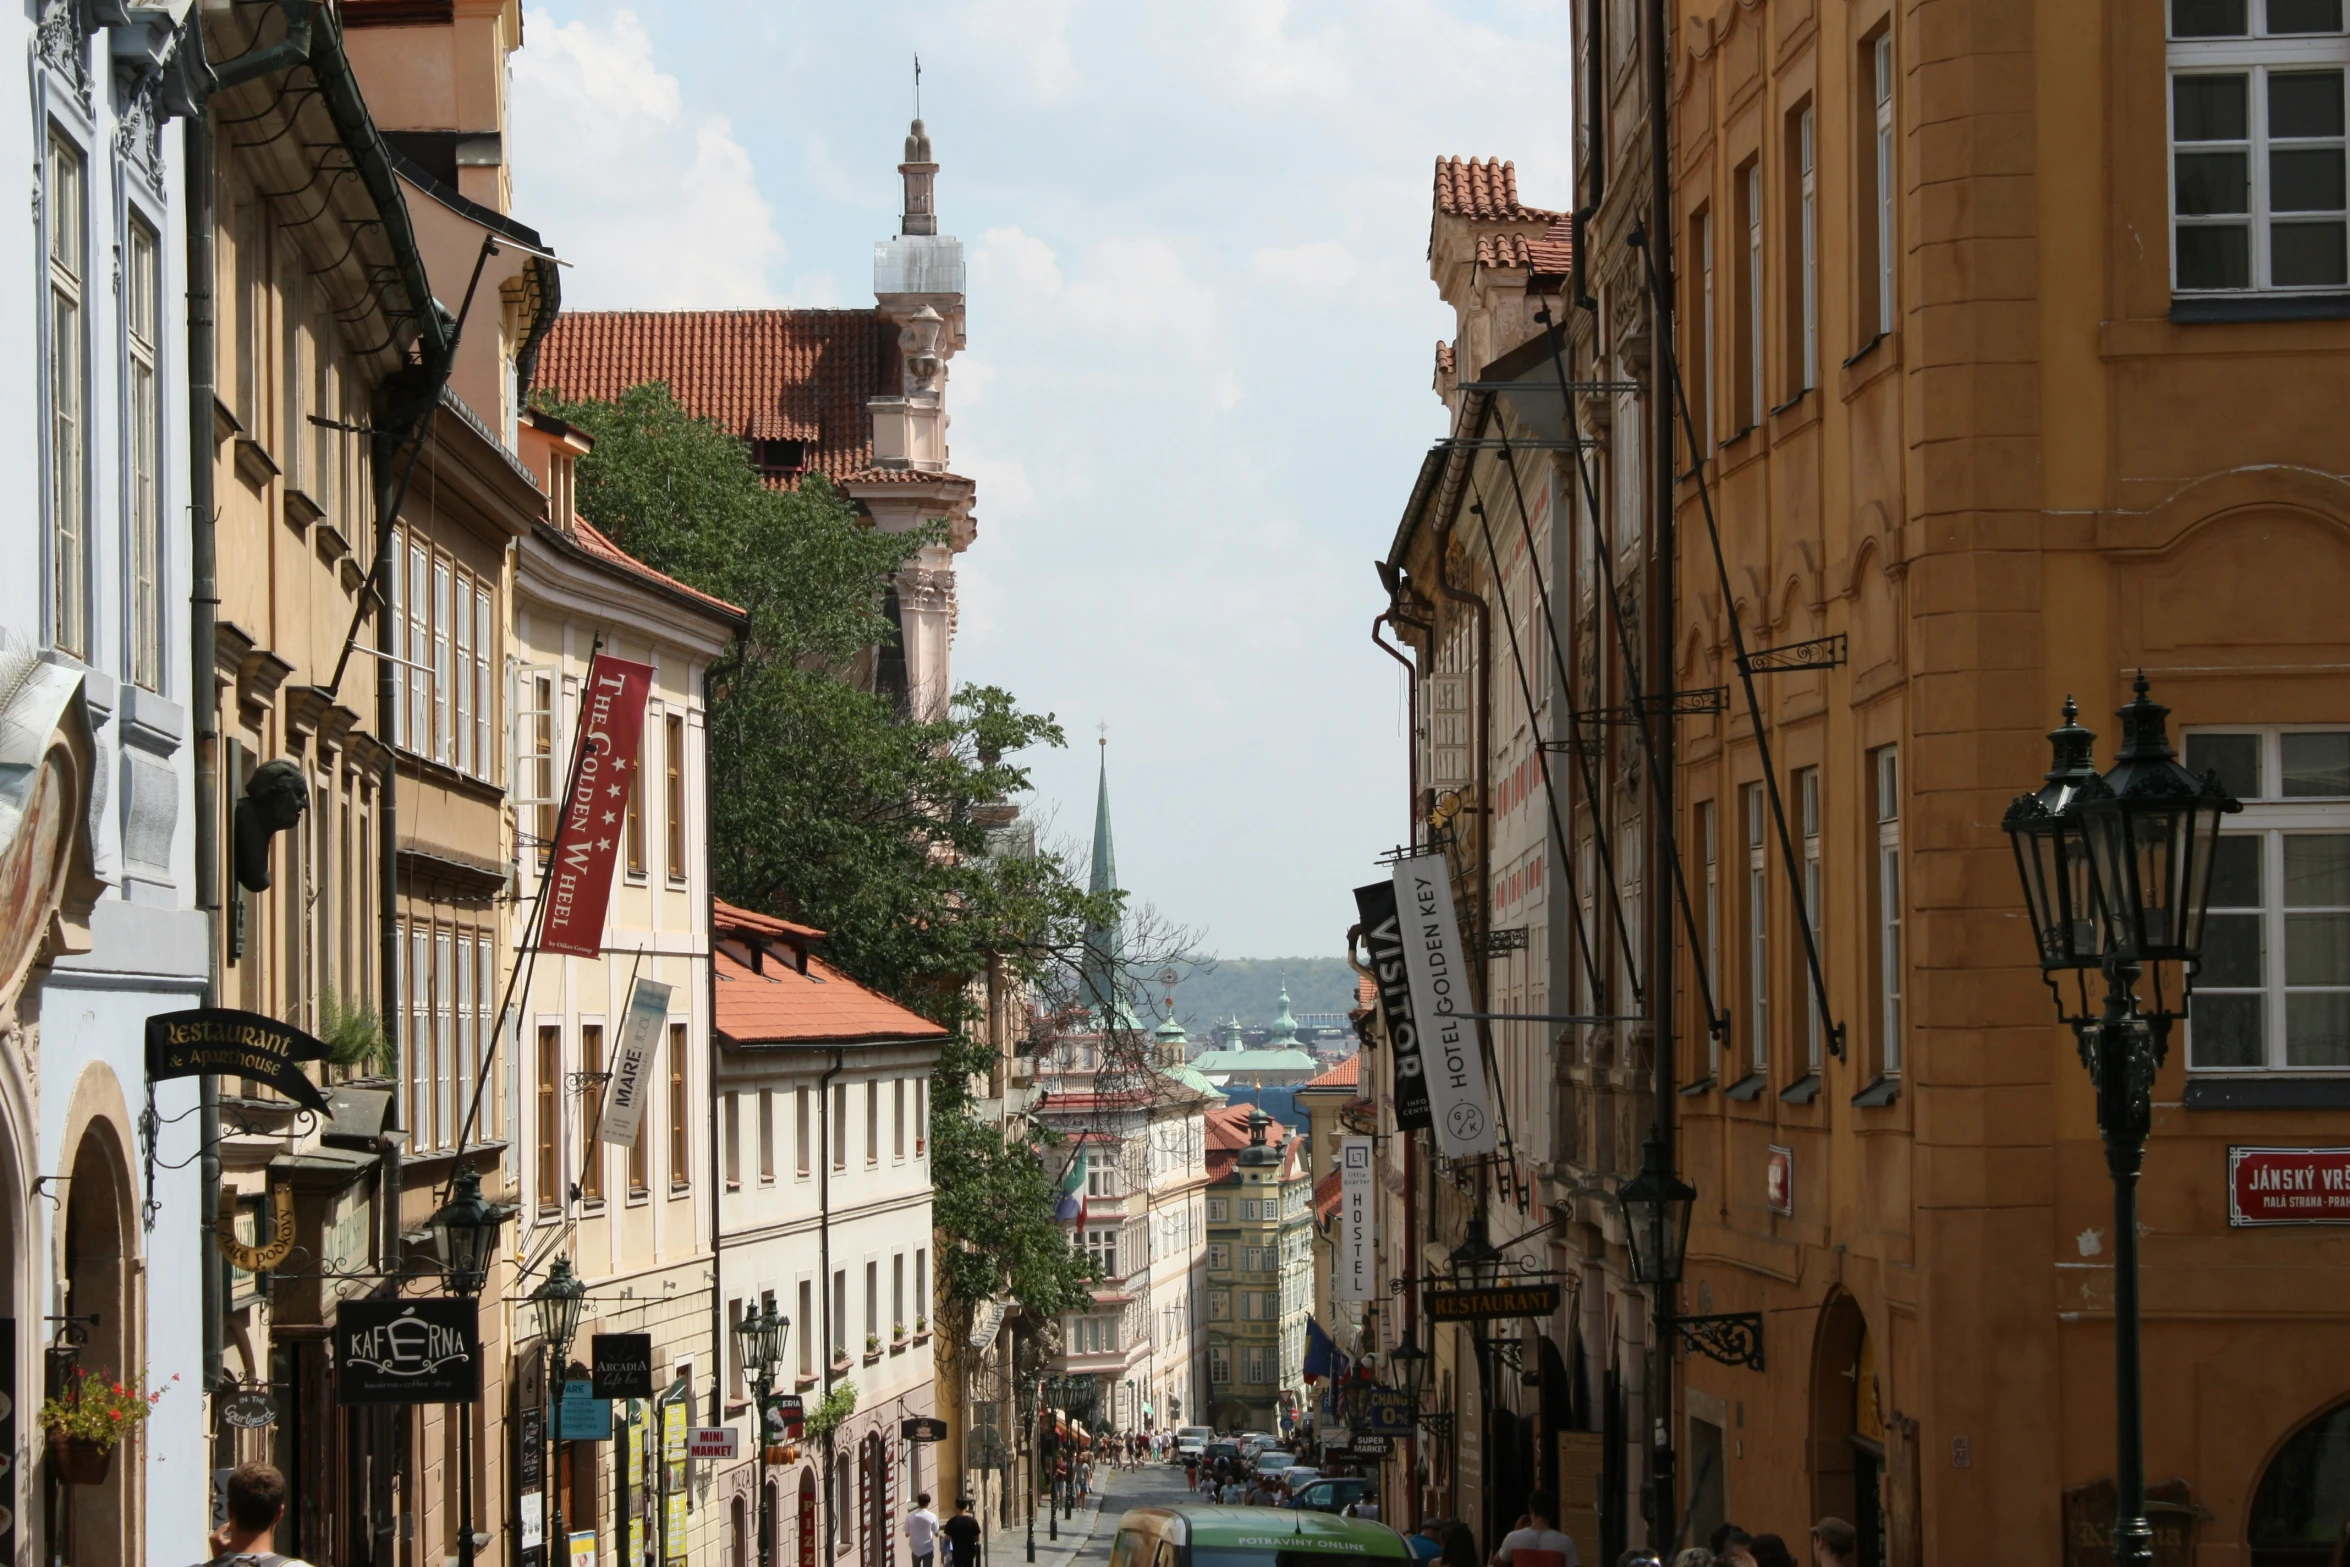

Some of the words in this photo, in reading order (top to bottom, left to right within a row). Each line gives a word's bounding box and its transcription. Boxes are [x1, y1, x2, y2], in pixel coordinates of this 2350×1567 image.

[1414, 877, 1437, 917] KEY
[1423, 923, 1454, 1017] GOLDEN
[1370, 915, 1422, 1081] VISITOR
[1441, 1020, 1468, 1089] HOTEL
[615, 1048, 642, 1108] MARE
[1407, 1099, 1427, 1107] INFO
[1403, 1106, 1430, 1116] CENTR
[2249, 1164, 2315, 1190] JÁNSKÝ
[2263, 1194, 2287, 1208] MALÁ
[2289, 1197, 2322, 1208] STRANA
[1353, 1193, 1363, 1291] HOSTEL
[1434, 1292, 1550, 1315] RESTAURANT
[252, 1396, 266, 1405] THE
[700, 1431, 724, 1442] MINI
[1357, 1436, 1384, 1445] SUPER
[691, 1446, 732, 1457] MARKET
[1354, 1445, 1388, 1453] MARKET
[1238, 1537, 1313, 1547] POTRAVINY
[1317, 1539, 1366, 1552] ONLINE
